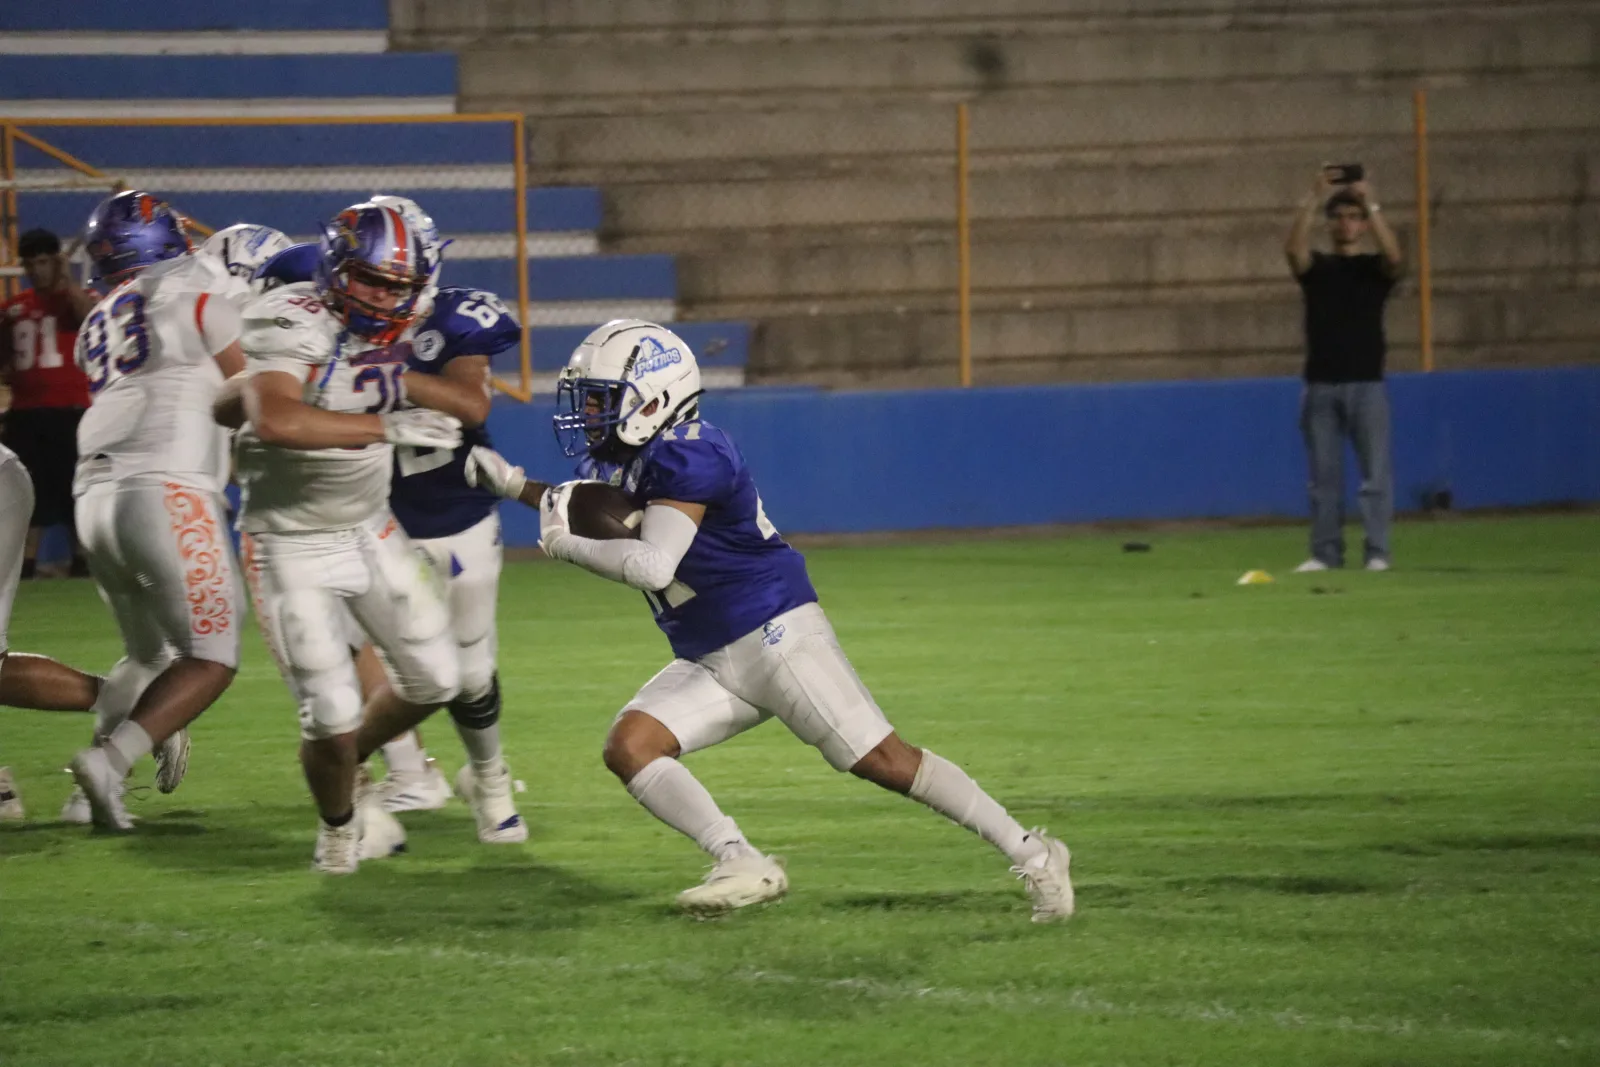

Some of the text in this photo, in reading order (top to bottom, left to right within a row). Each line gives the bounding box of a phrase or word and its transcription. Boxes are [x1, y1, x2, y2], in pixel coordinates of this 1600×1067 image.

[13, 315, 64, 370] 91
[83, 291, 150, 392] 93
[635, 345, 681, 381] POTROS
